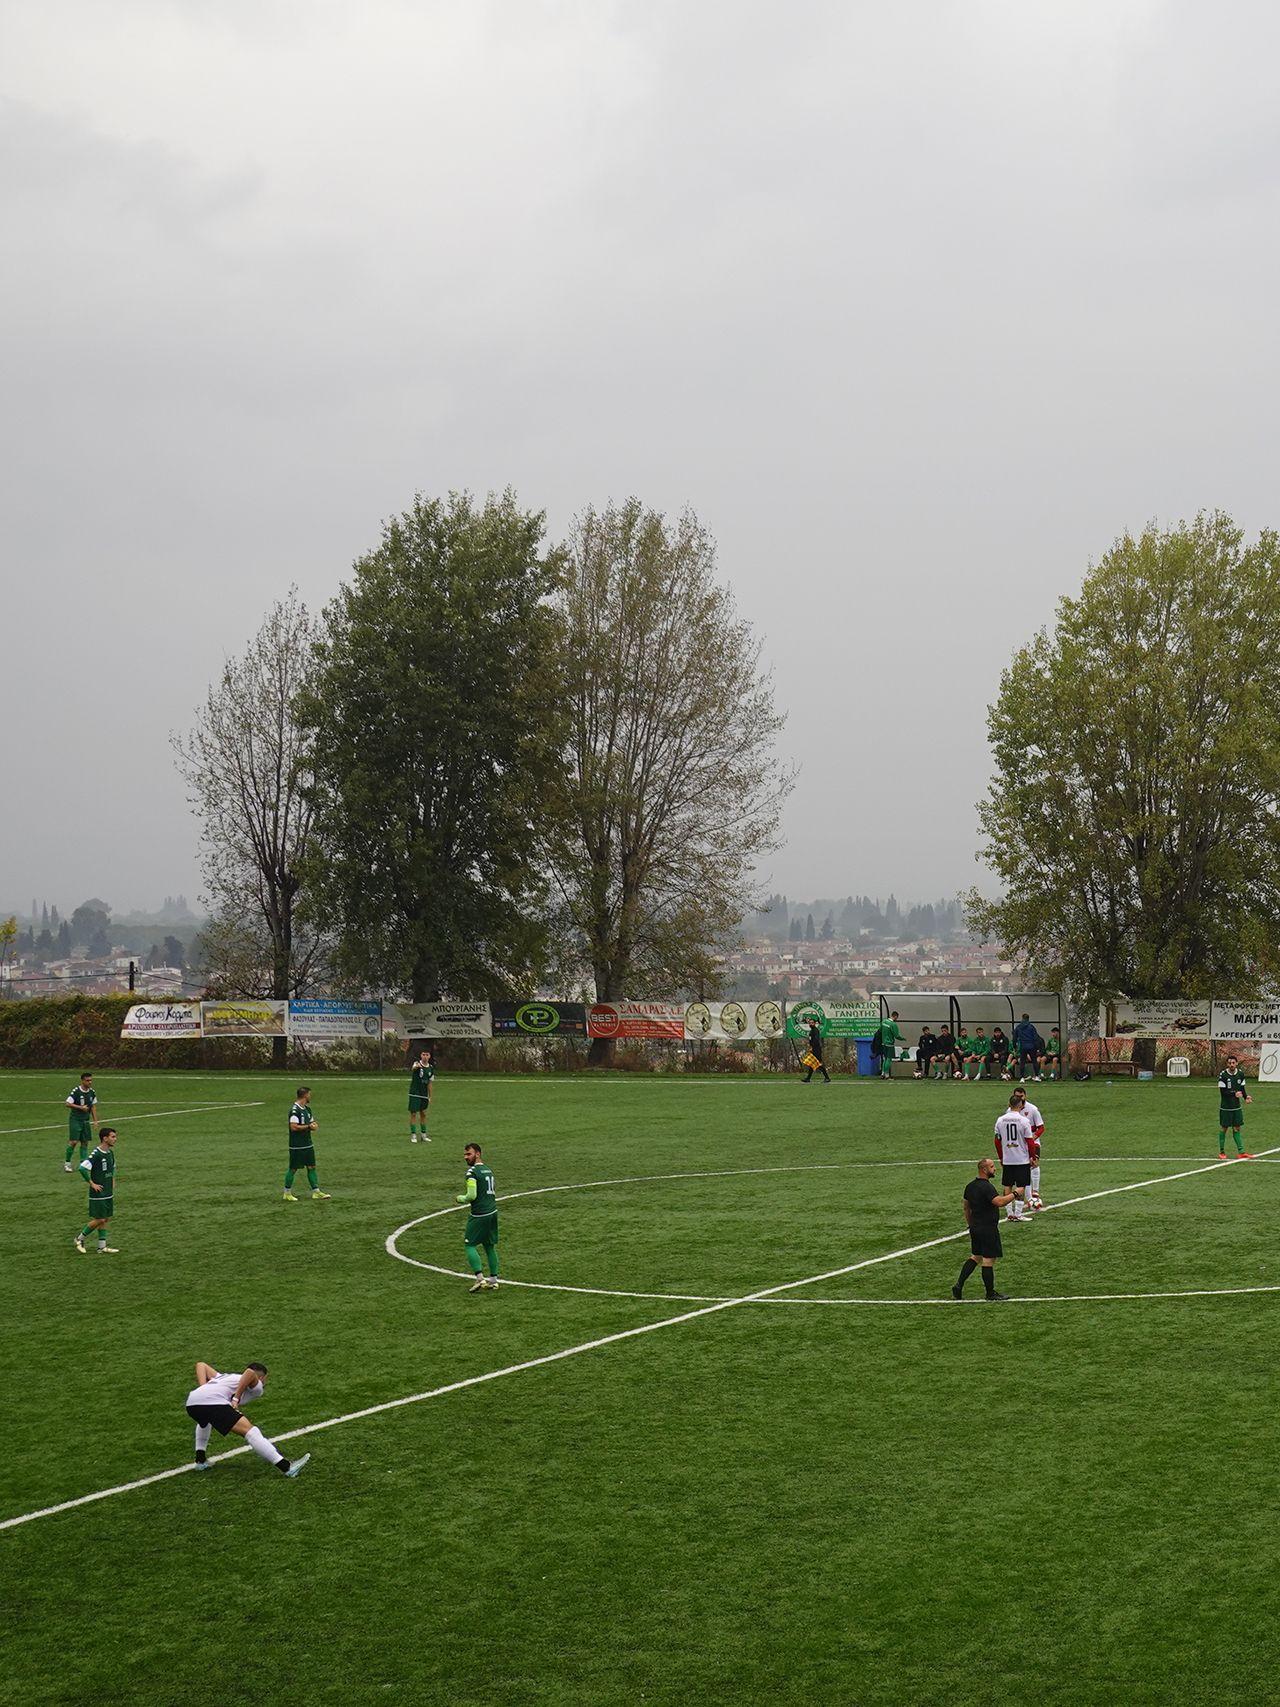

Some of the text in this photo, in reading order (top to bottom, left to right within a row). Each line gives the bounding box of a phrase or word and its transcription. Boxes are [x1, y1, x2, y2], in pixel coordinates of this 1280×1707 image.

[830, 1002, 880, 1010] ΑΘΑΝΑΣΙΟΣ
[1214, 1002, 1260, 1010] ΜΕΤΑΦΟΡΕΣ
[591, 1014, 617, 1022] BEST
[1006, 1123, 1018, 1141] 10
